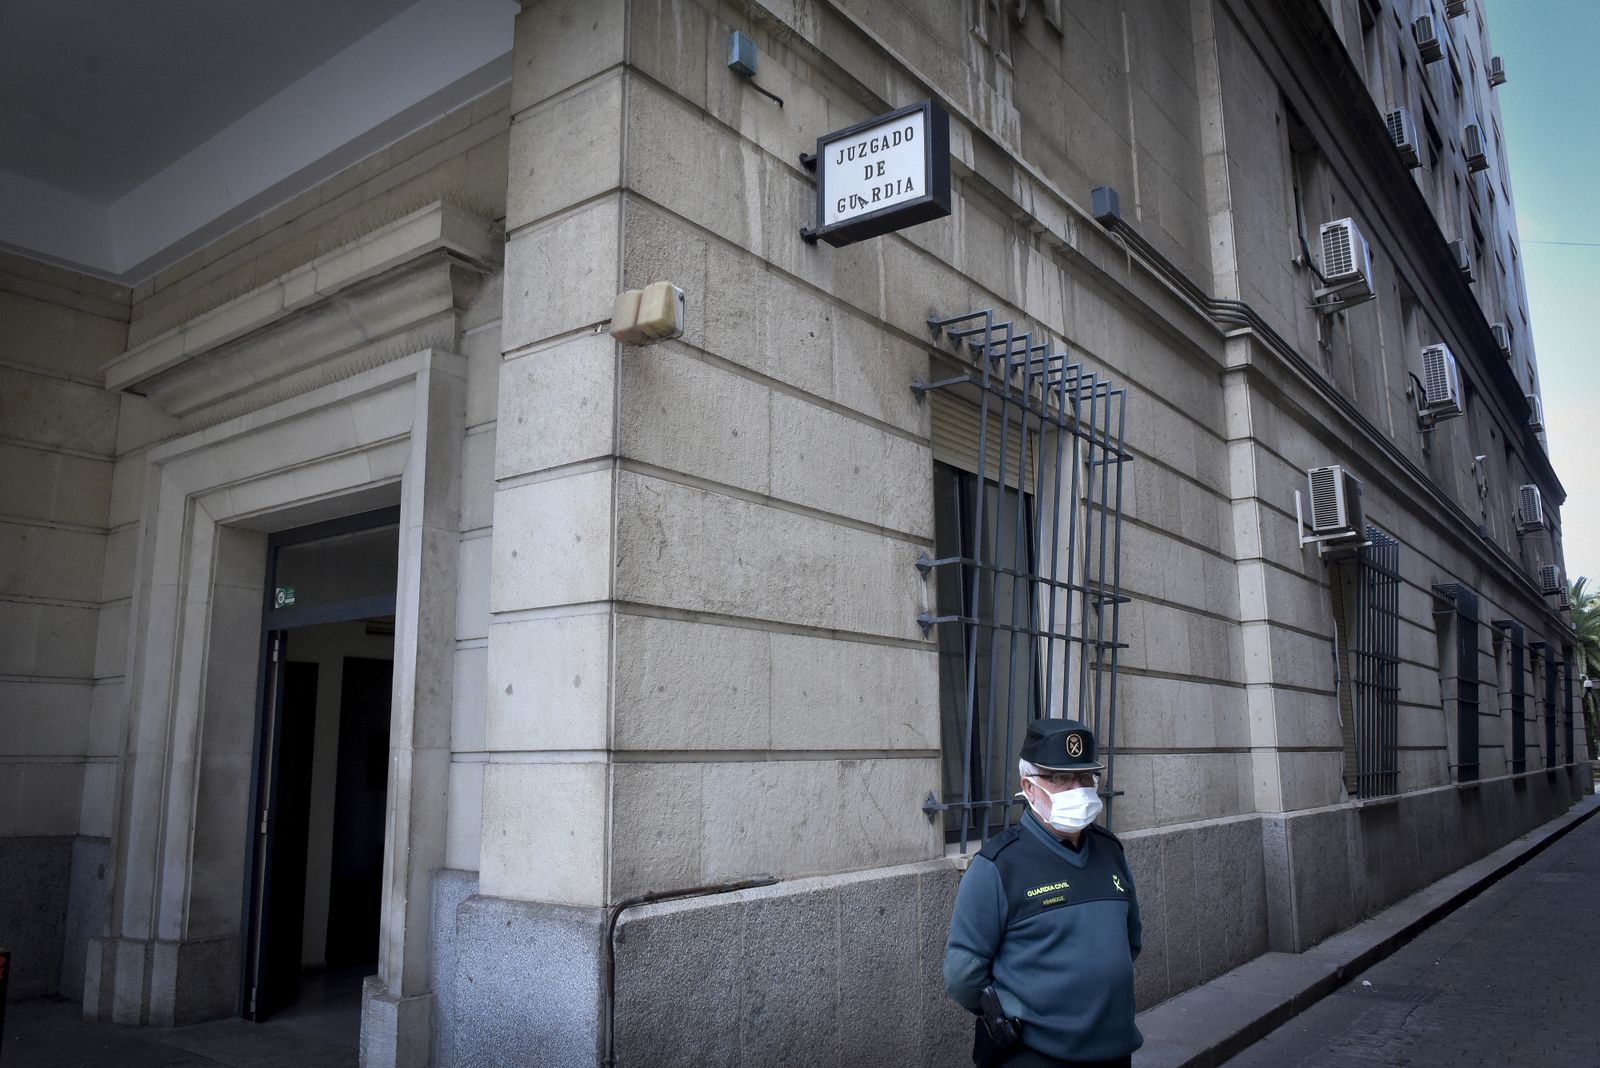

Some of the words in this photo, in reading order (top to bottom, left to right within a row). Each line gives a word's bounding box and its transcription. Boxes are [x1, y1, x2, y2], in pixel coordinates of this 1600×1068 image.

[837, 126, 914, 165] JUZGADO
[864, 160, 886, 180] DE
[837, 177, 914, 213] GUARDIA
[1027, 884, 1056, 897] GUARDIA
[1055, 881, 1070, 890] CIVIL
